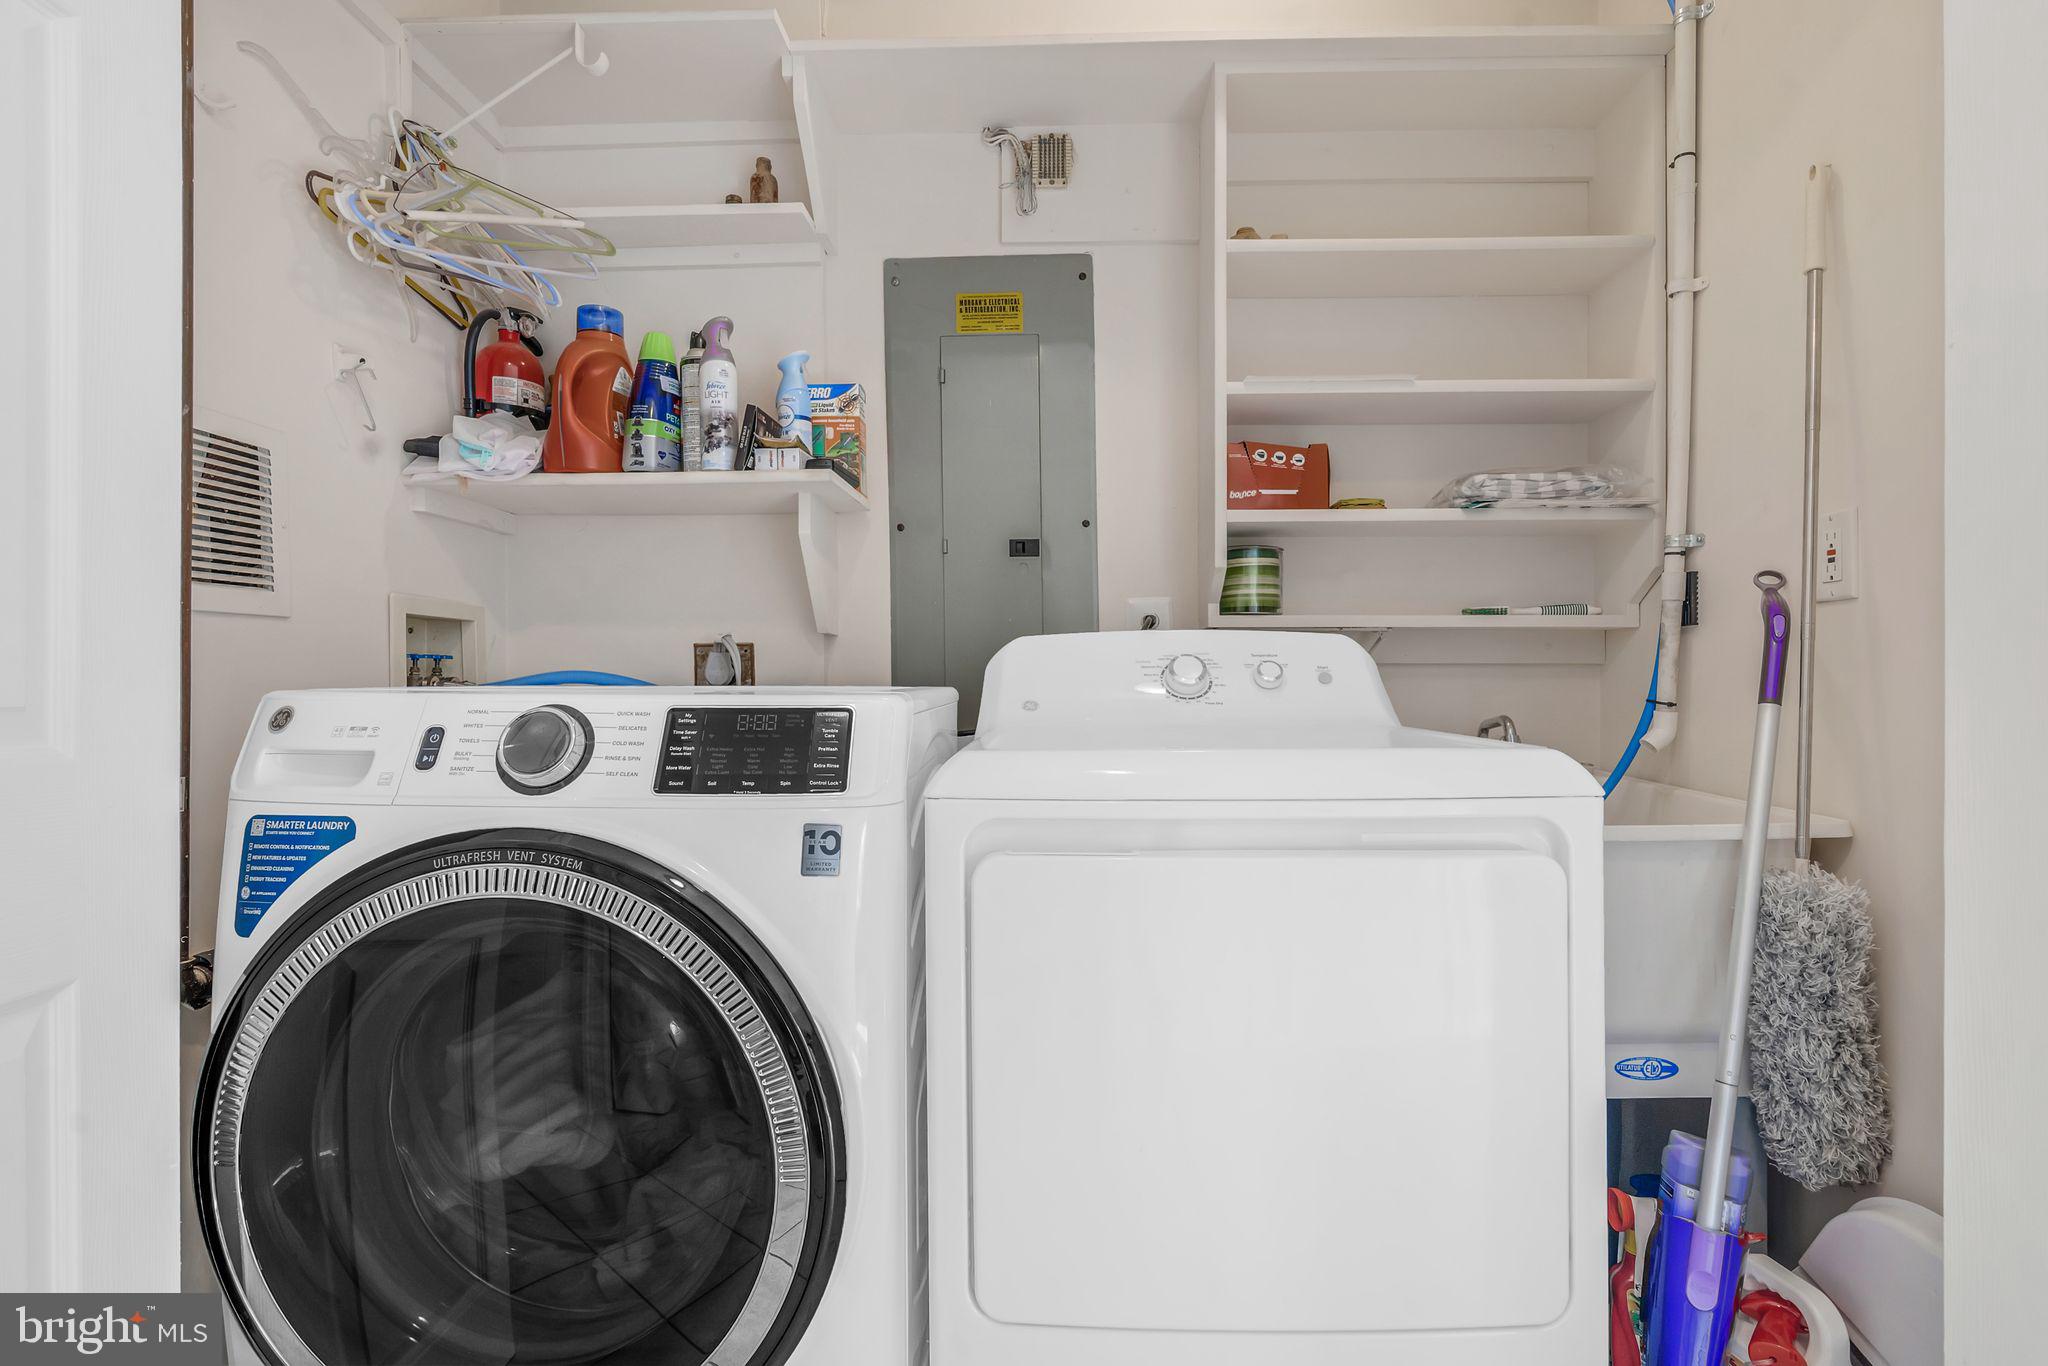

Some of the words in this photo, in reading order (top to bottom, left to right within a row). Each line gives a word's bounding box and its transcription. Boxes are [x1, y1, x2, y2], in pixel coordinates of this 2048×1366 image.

[989, 298, 1020, 306] ELECTRICAL
[705, 390, 728, 399] LIGHT
[808, 387, 831, 400] ERRO
[1229, 489, 1257, 499] bounce
[266, 820, 305, 829] SMARTER
[306, 821, 350, 831] LAUNDRY
[804, 829, 841, 856] 10
[433, 851, 501, 868] ULTRAFRESH
[507, 850, 536, 861] VENT
[541, 853, 583, 870] SYSTEM
